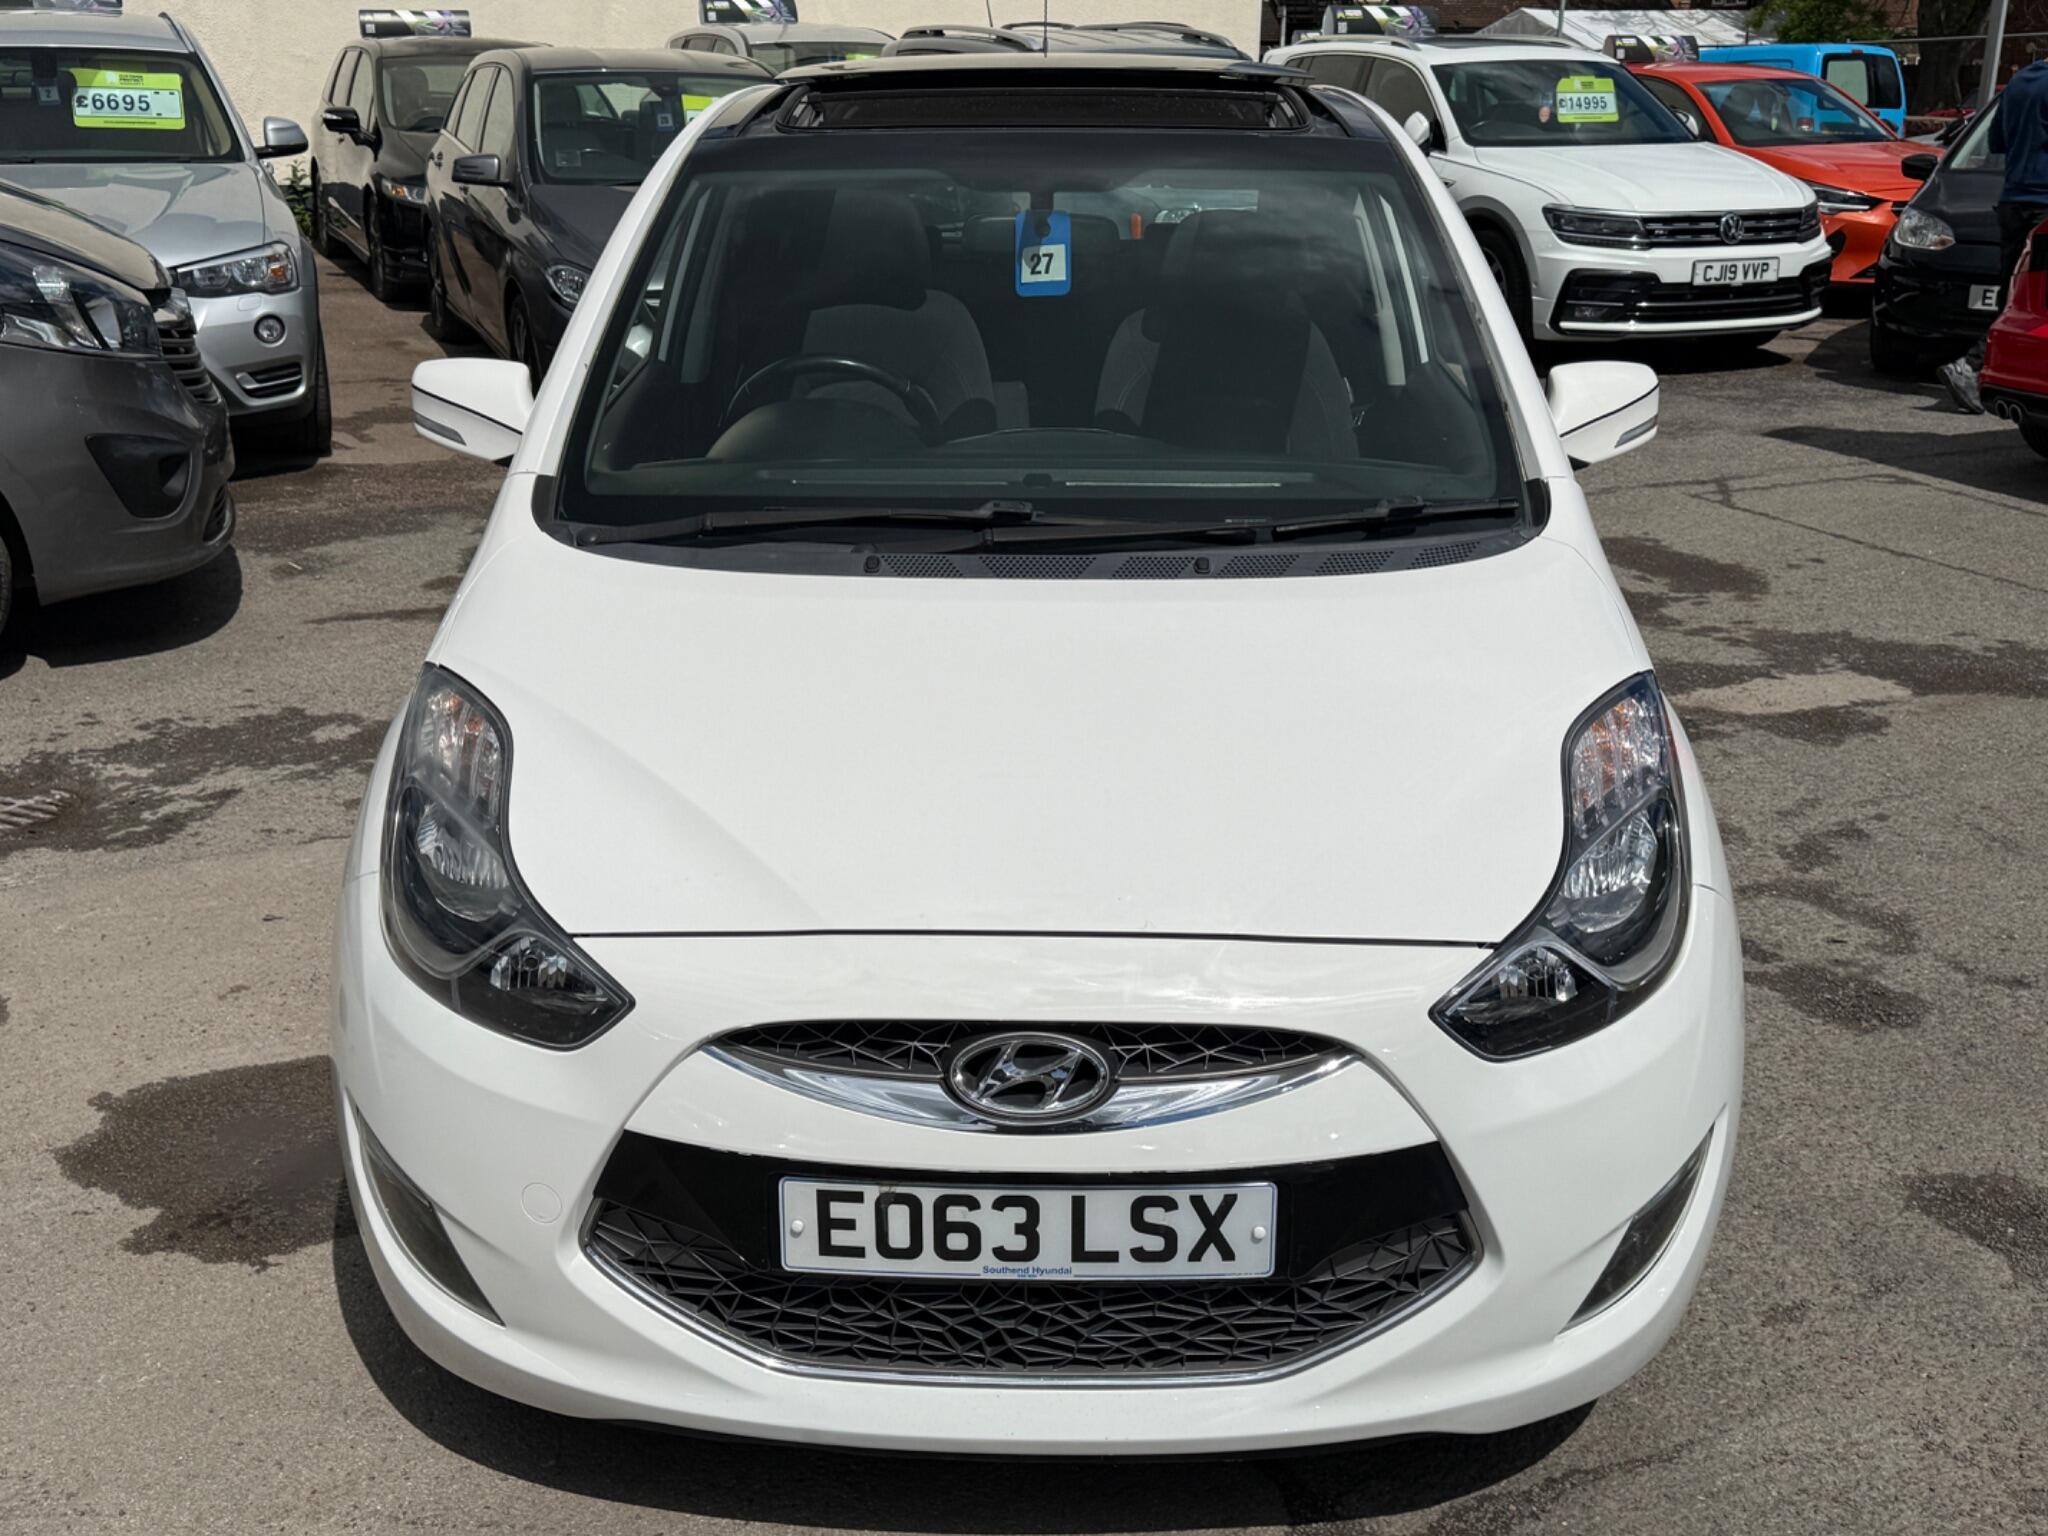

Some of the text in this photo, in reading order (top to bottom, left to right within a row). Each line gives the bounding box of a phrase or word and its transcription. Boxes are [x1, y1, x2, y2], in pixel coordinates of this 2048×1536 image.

[75, 93, 151, 112] £6695
[1030, 253, 1054, 275] 27
[1703, 262, 1770, 282] CJ19 VVP
[1071, 1193, 1239, 1264] LSX
[983, 1265, 1072, 1276] Southend Hyundai
